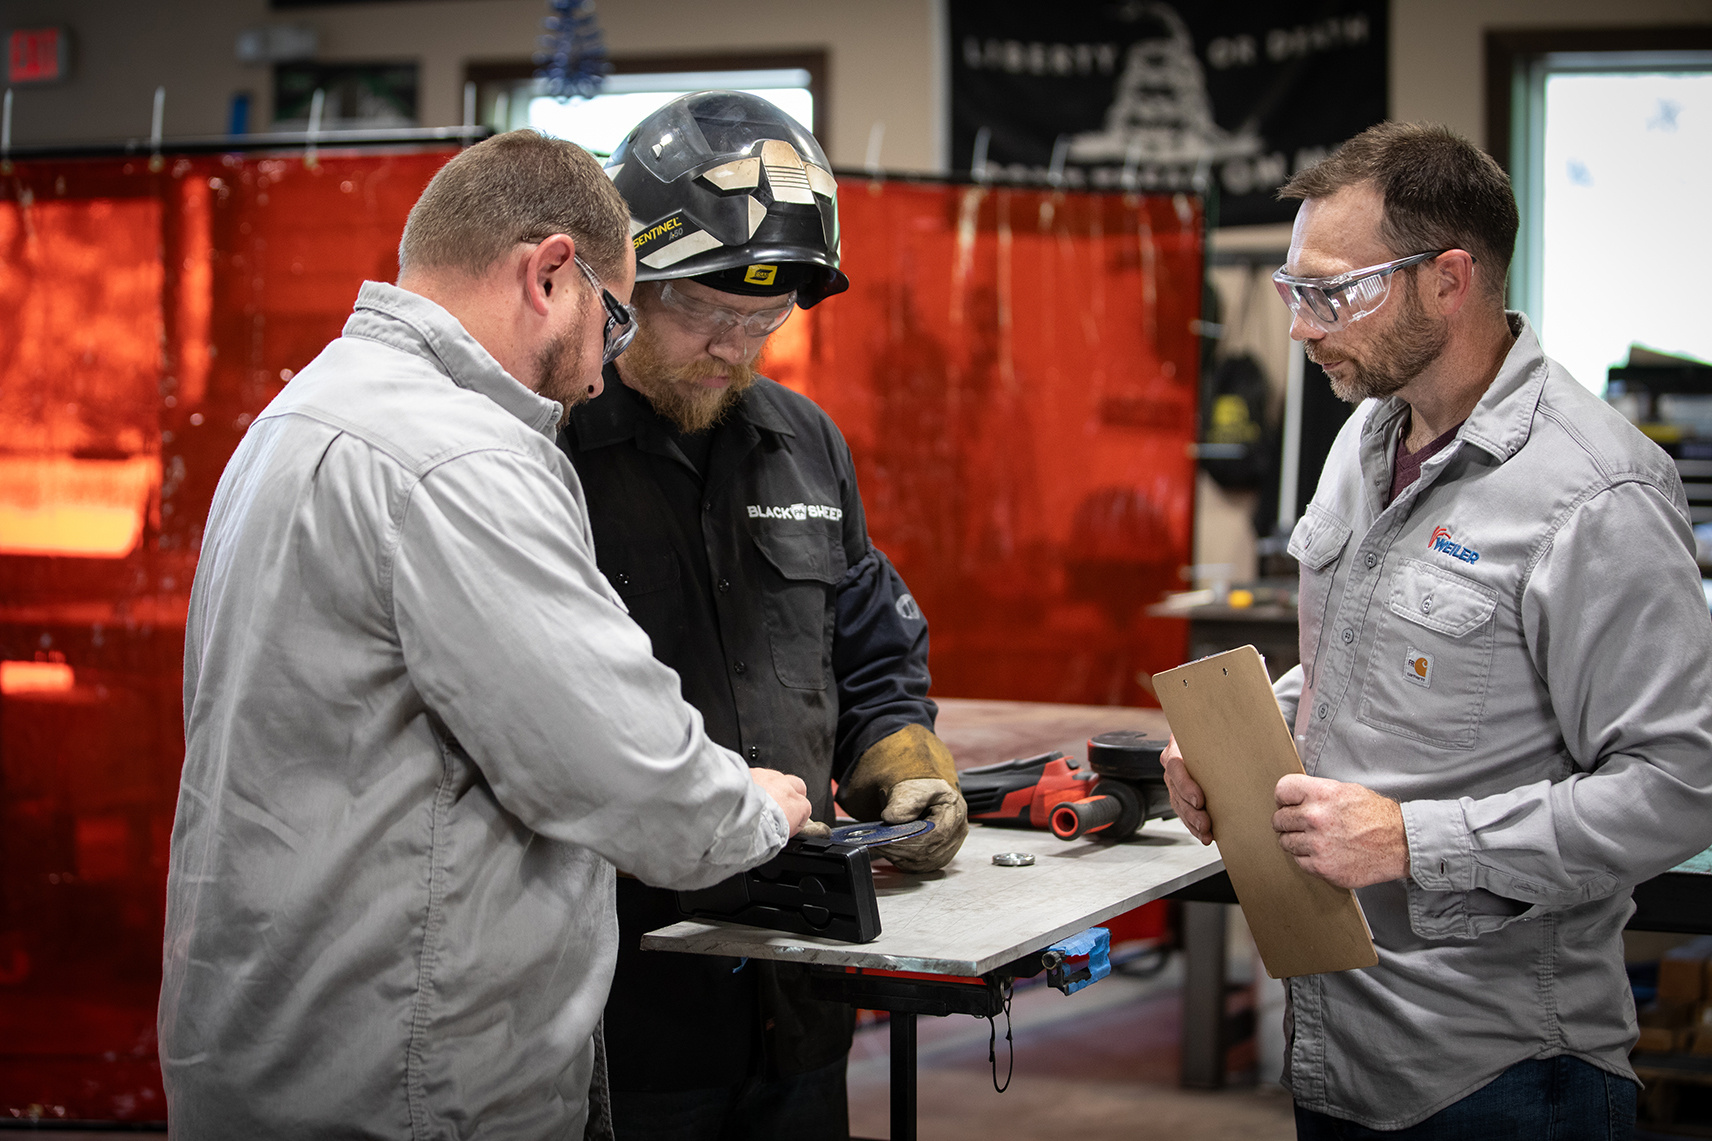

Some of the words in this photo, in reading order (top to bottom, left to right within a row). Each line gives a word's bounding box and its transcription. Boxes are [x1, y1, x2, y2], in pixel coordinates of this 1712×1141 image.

[1206, 34, 1257, 70] OR
[633, 217, 682, 249] SENTINEL
[747, 505, 793, 519] BLACK
[807, 505, 843, 521] SHEEP
[1434, 537, 1480, 565] WEILER
